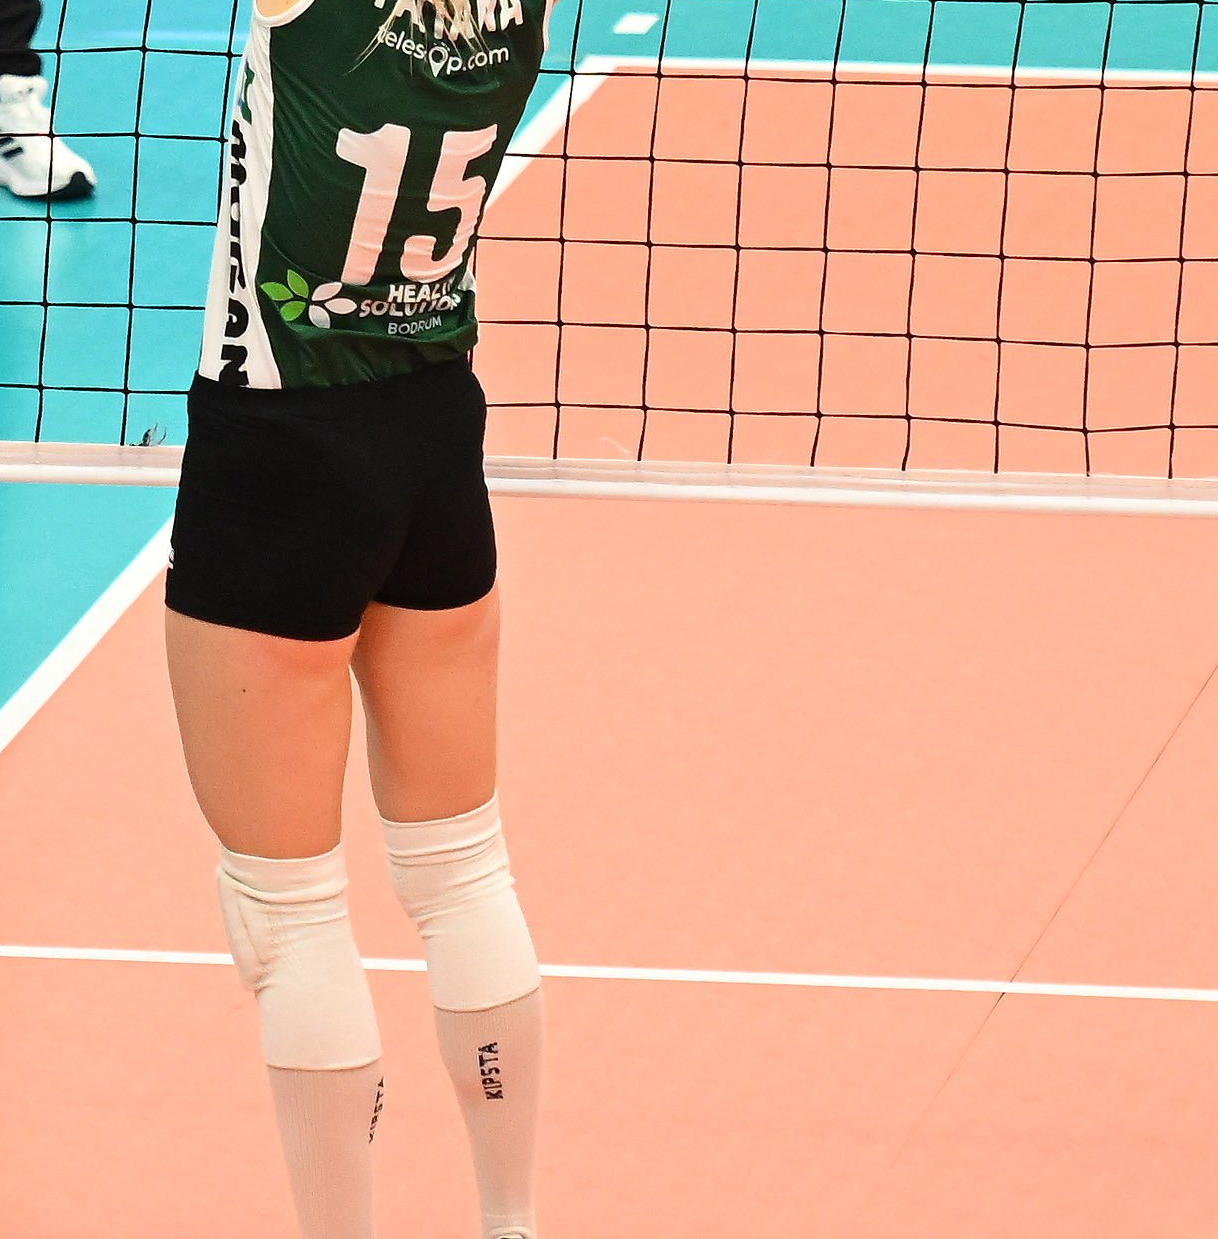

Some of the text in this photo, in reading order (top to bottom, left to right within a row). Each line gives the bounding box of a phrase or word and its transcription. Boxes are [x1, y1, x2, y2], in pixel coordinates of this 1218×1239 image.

[335, 122, 498, 287] 15
[387, 315, 443, 335] BODRUM
[477, 1041, 504, 1100] KIPSTA
